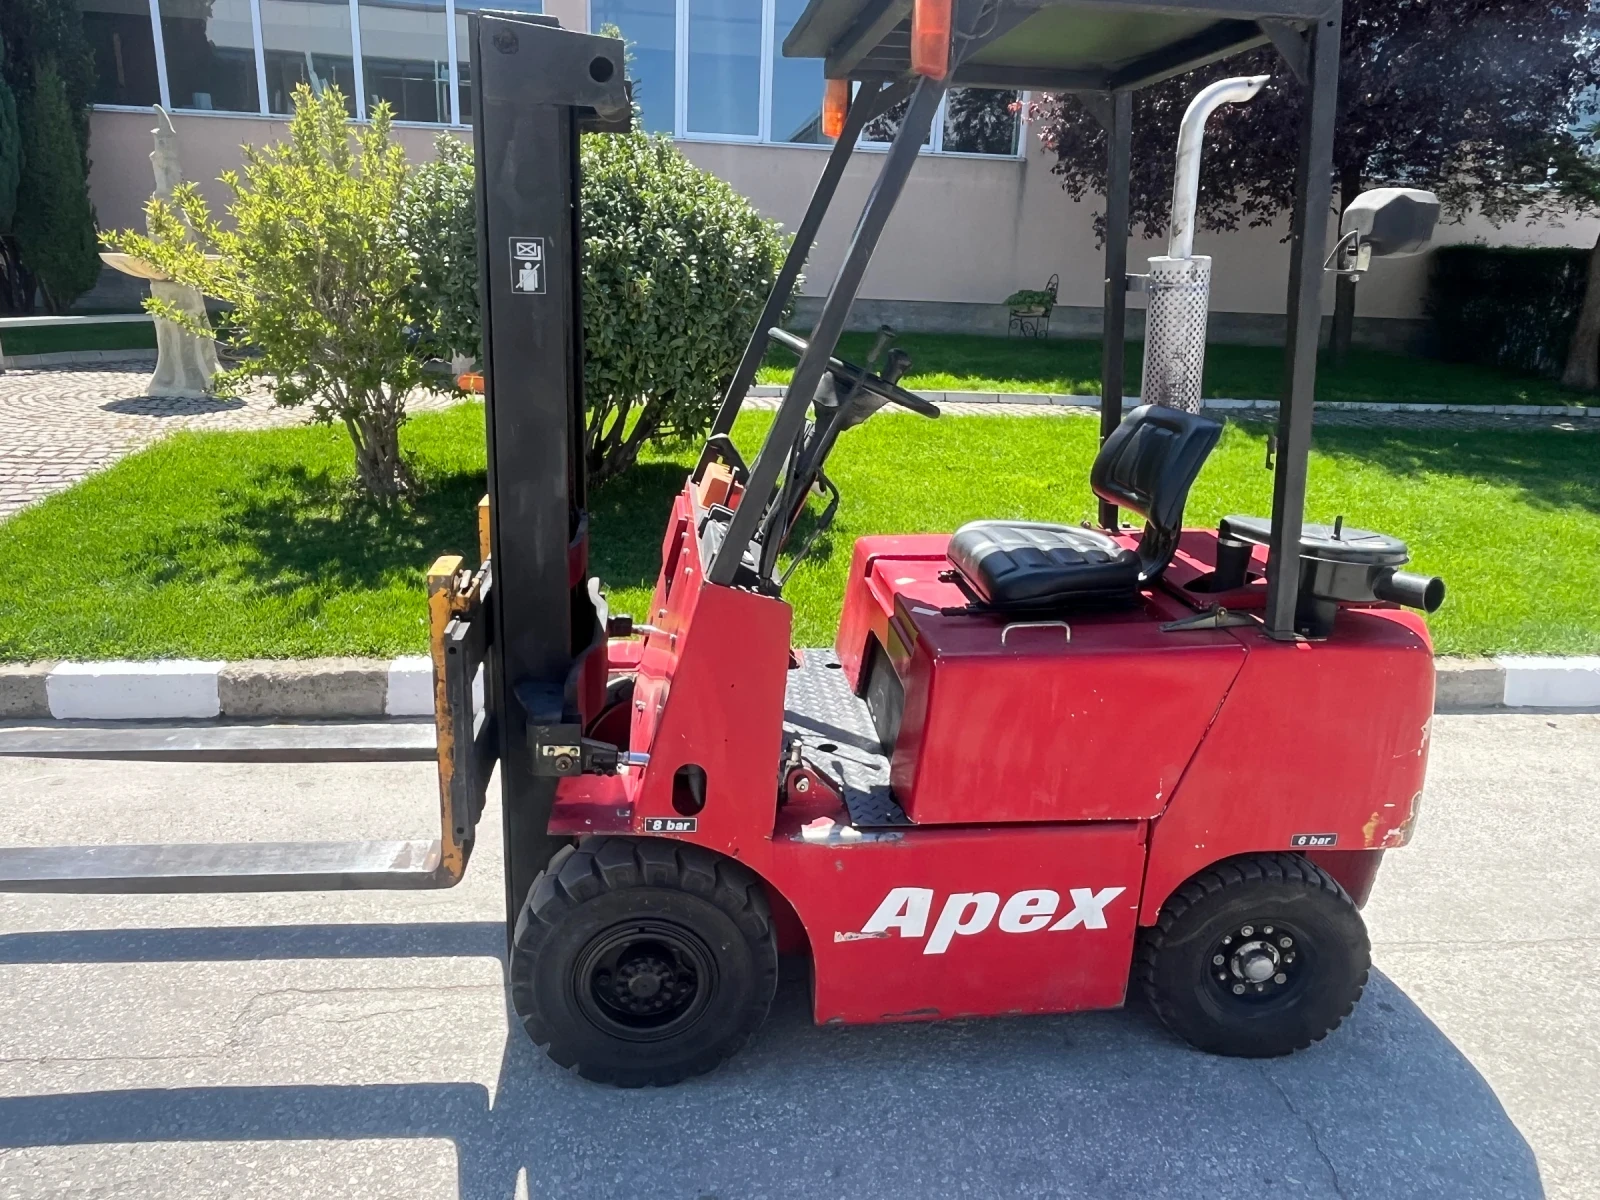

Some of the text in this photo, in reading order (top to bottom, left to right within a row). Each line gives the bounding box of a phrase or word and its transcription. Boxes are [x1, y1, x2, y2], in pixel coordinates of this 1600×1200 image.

[653, 820, 690, 830] 8 bar
[1298, 836, 1331, 845] 6 bar
[861, 887, 1126, 954] Apex
